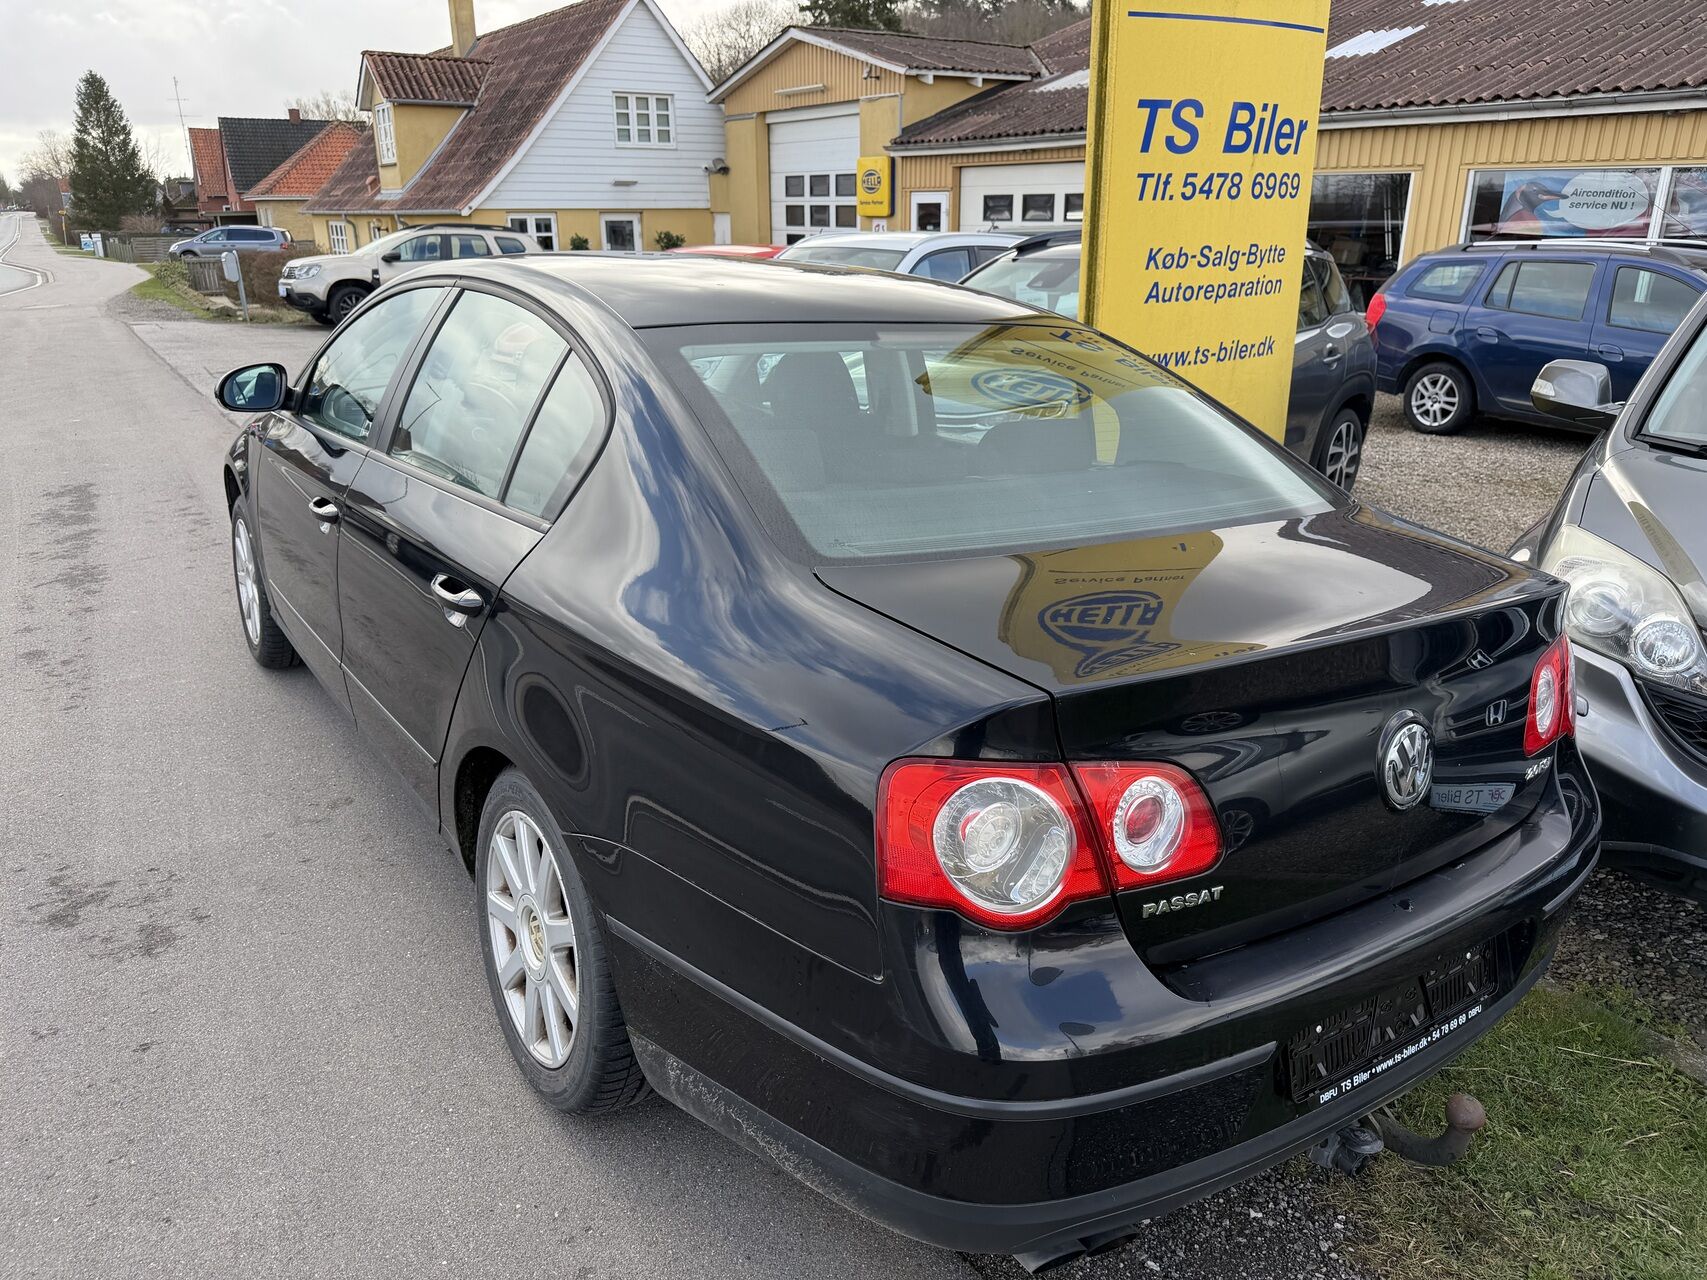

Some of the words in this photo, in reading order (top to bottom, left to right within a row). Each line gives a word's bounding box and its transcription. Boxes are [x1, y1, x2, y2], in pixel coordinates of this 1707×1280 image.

[1136, 98, 1204, 155] TS
[1222, 101, 1308, 156] Biler
[1136, 172, 1175, 201] Tlf.
[1181, 172, 1243, 200] 5478
[1250, 172, 1301, 200] 6969
[1571, 188, 1635, 198] Aircondition
[1569, 201, 1607, 209] service
[1610, 201, 1628, 210] NU
[1145, 243, 1286, 272] Køb-Salg-Bytte
[1144, 275, 1283, 304] Autoreparation
[1147, 336, 1275, 368] ww.ts-biler.dk
[1142, 885, 1224, 919] PASSAT
[1320, 1087, 1338, 1104] DBFU
[1340, 1079, 1352, 1093] TS
[1353, 1070, 1371, 1087] Biler
[1432, 1028, 1440, 1041] 54
[1441, 1023, 1449, 1036] 78
[1450, 1018, 1458, 1030] 69
[1458, 1013, 1466, 1025] 69
